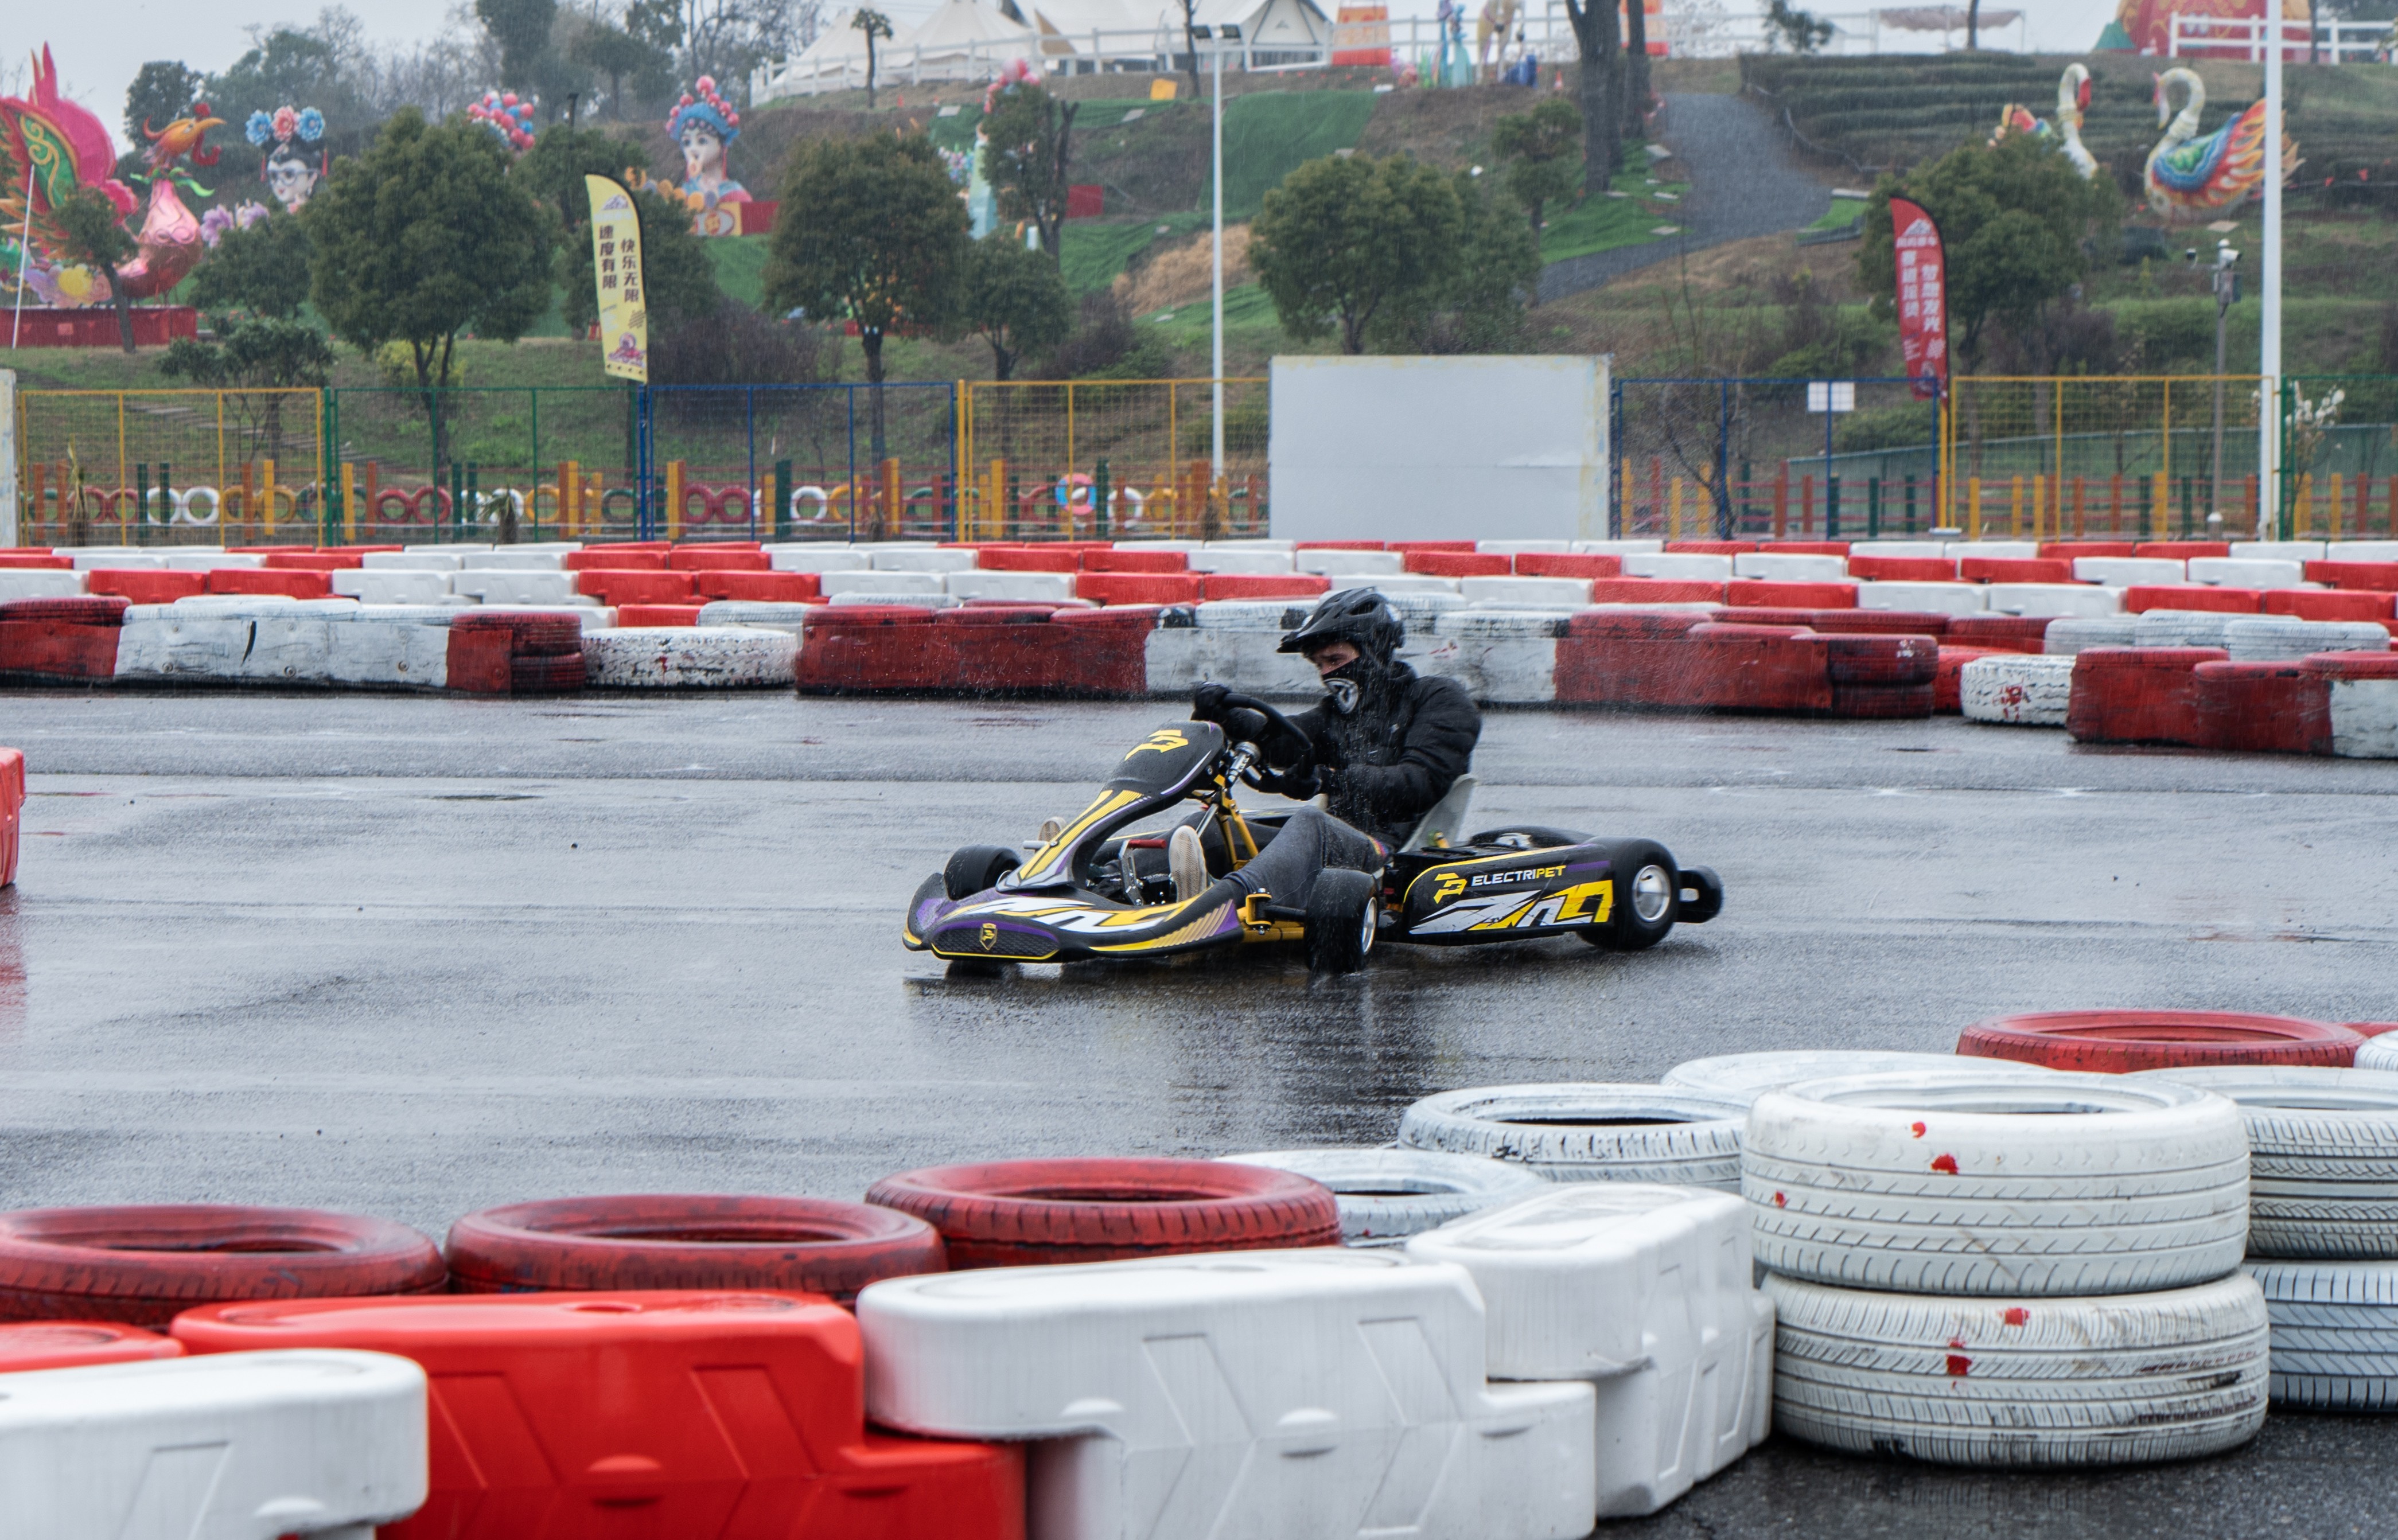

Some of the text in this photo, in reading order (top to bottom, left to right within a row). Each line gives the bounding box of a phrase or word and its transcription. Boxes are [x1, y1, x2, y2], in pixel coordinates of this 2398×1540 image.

[599, 225, 617, 290] 速度有限
[621, 238, 639, 303] 快乐无限
[1472, 865, 1566, 887] ELECTRIPET
